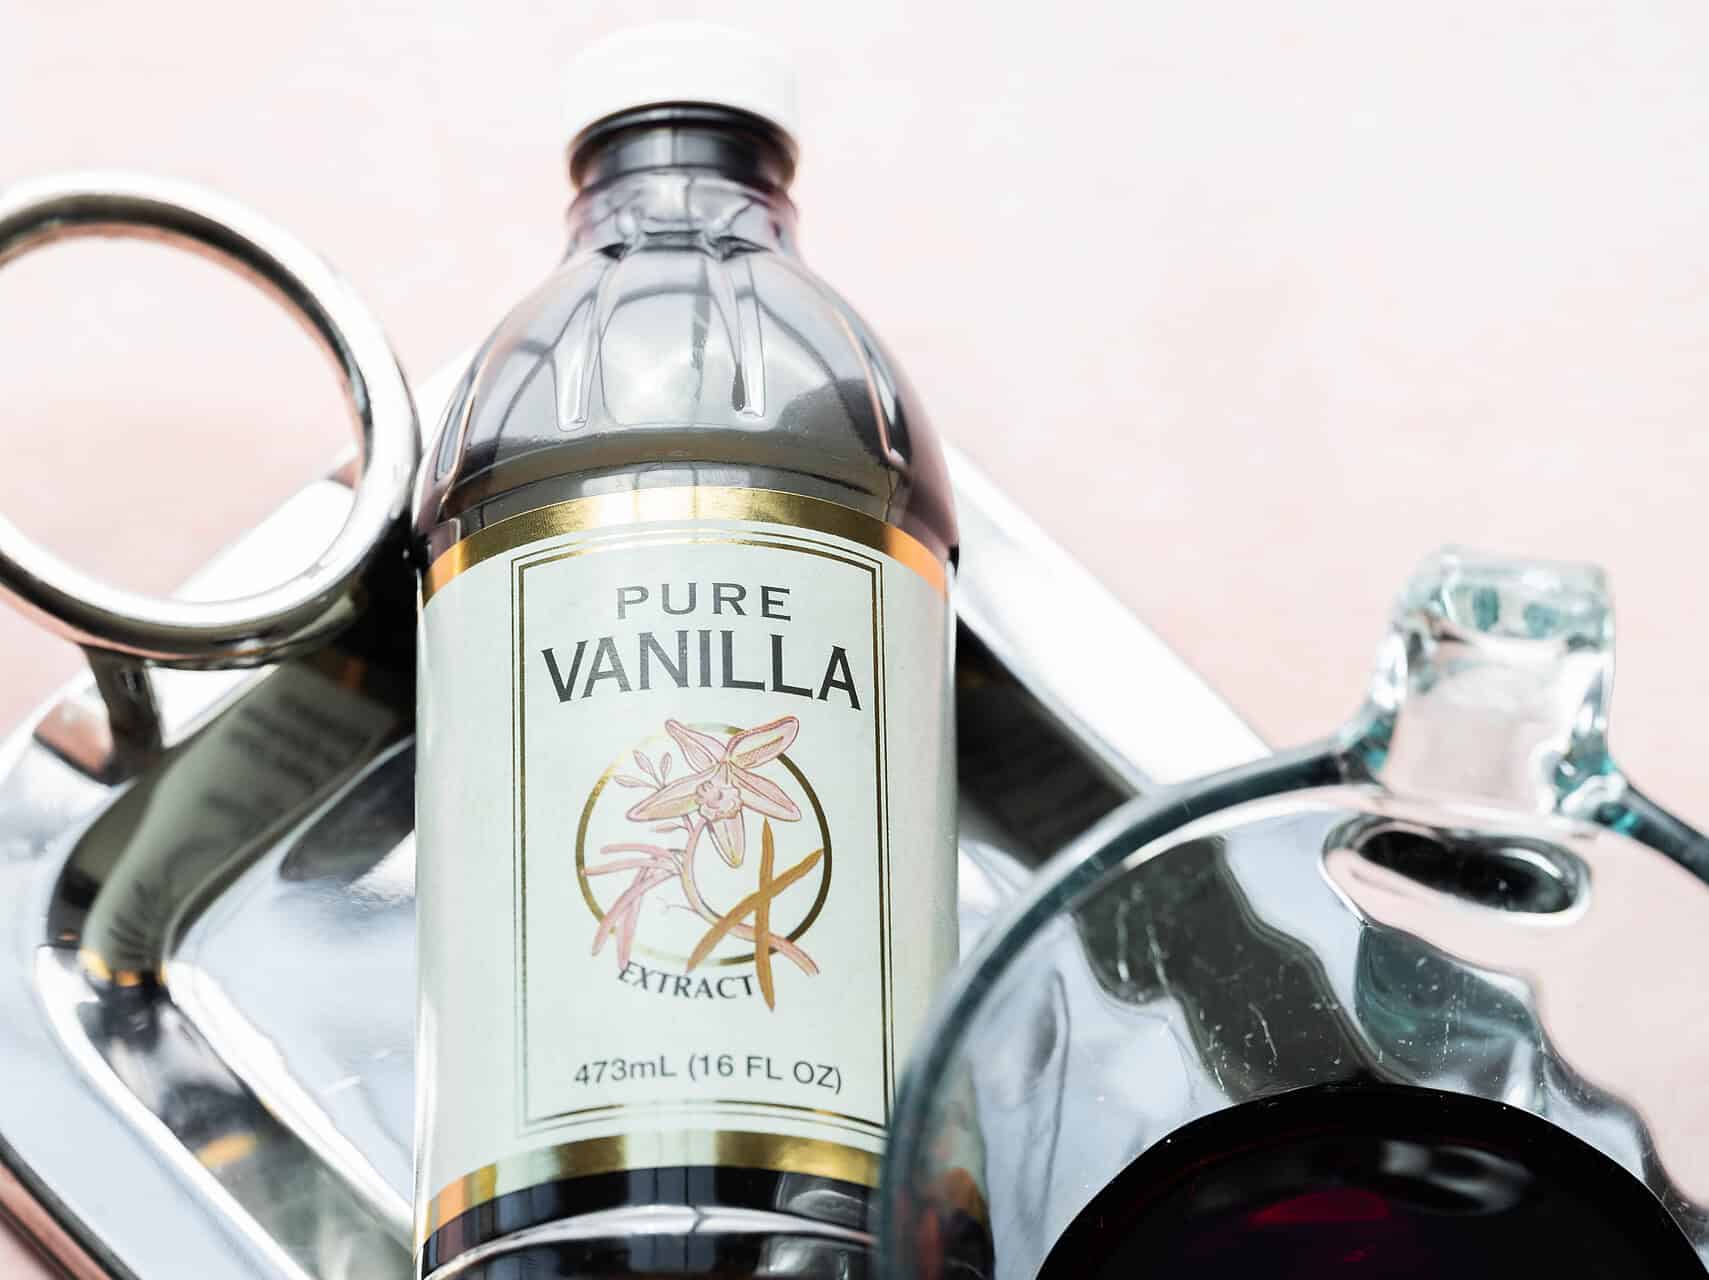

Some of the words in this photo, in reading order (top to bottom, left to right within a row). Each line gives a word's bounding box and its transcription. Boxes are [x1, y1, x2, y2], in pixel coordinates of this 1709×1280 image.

[617, 582, 792, 621] PURE
[541, 629, 862, 710] VANILLA
[618, 961, 755, 1000] EXTRACT
[574, 1055, 676, 1086] 473mL
[688, 1054, 734, 1082] (16
[746, 1055, 783, 1081] FL
[793, 1060, 842, 1095] OZ)
